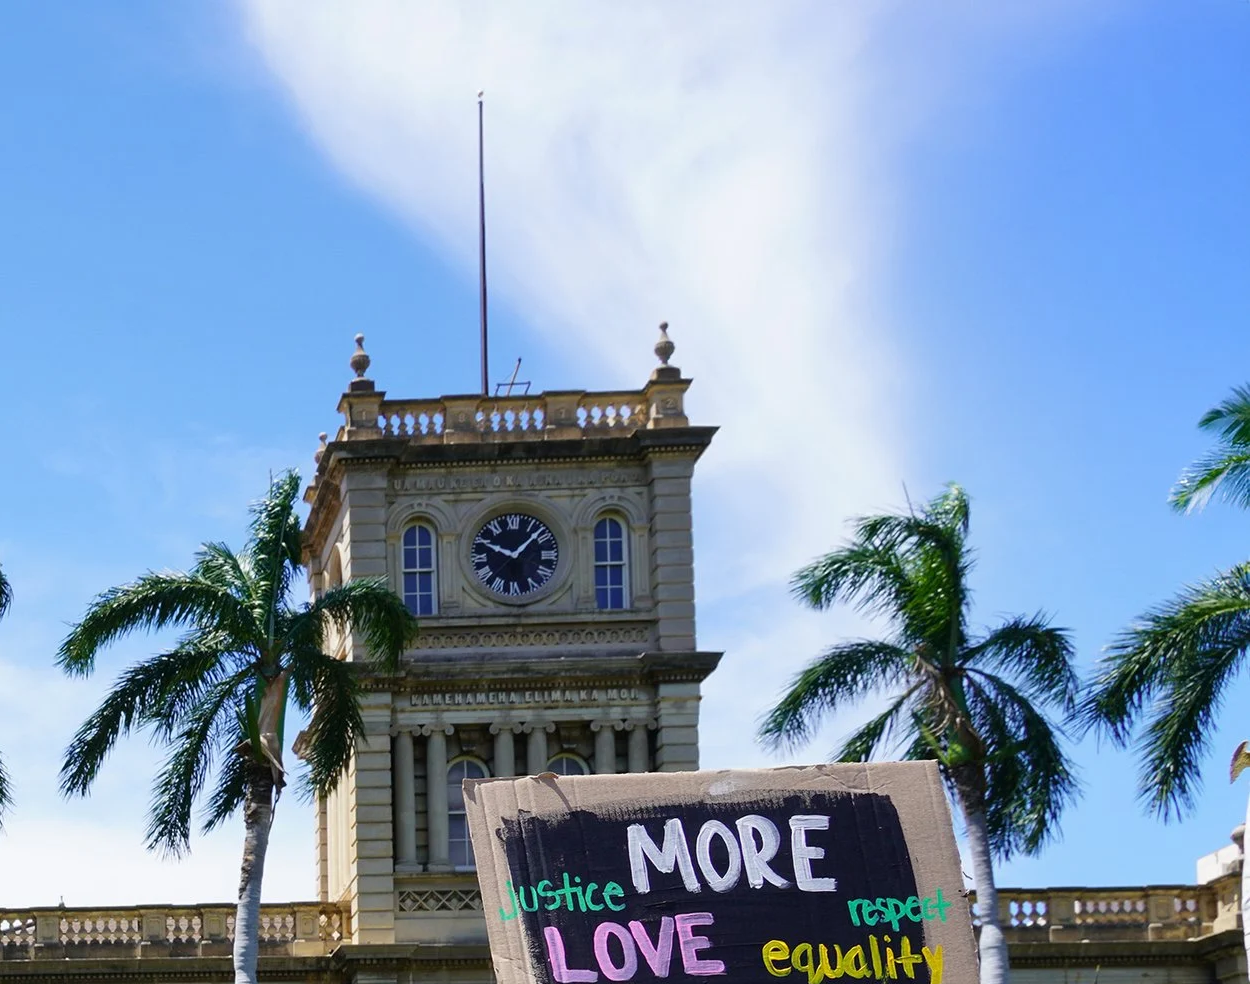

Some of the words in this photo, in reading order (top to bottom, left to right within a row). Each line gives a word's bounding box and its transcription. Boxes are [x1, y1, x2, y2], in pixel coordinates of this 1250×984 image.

[487, 519, 502, 536] XI
[506, 515, 520, 530] XII
[527, 519, 536, 532] I
[471, 553, 487, 562] IX
[541, 549, 557, 560] III
[491, 577, 505, 592] VII
[509, 581, 521, 595] VI
[527, 577, 540, 592] V
[411, 691, 517, 705] KAMEHAMEHA
[579, 689, 598, 701] KA
[627, 813, 839, 895] MORE
[498, 871, 627, 922] justice
[846, 887, 951, 934] respect
[544, 911, 728, 984] LOVE
